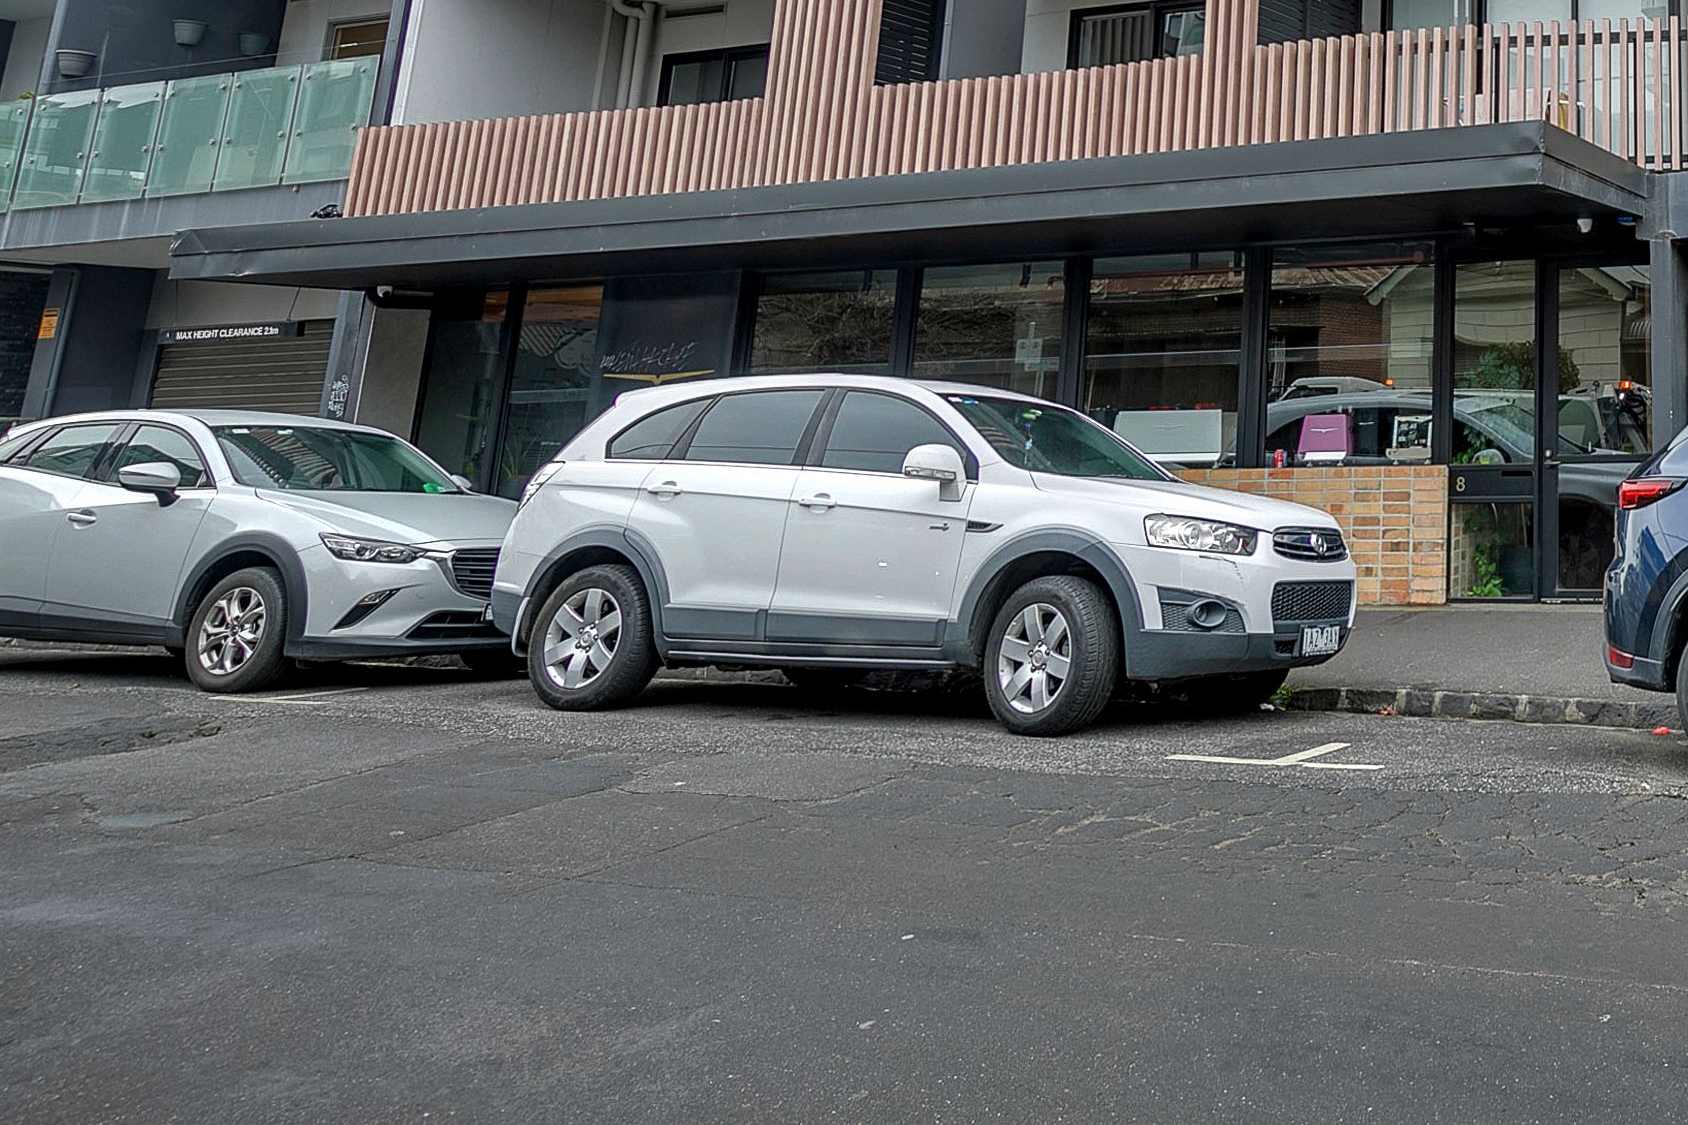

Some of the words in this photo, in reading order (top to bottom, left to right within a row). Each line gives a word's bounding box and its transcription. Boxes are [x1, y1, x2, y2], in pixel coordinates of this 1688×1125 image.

[176, 331, 192, 340] MAX
[193, 329, 218, 339] HEIGHT
[219, 327, 262, 338] CLEARANCE
[1456, 476, 1466, 492] 8
